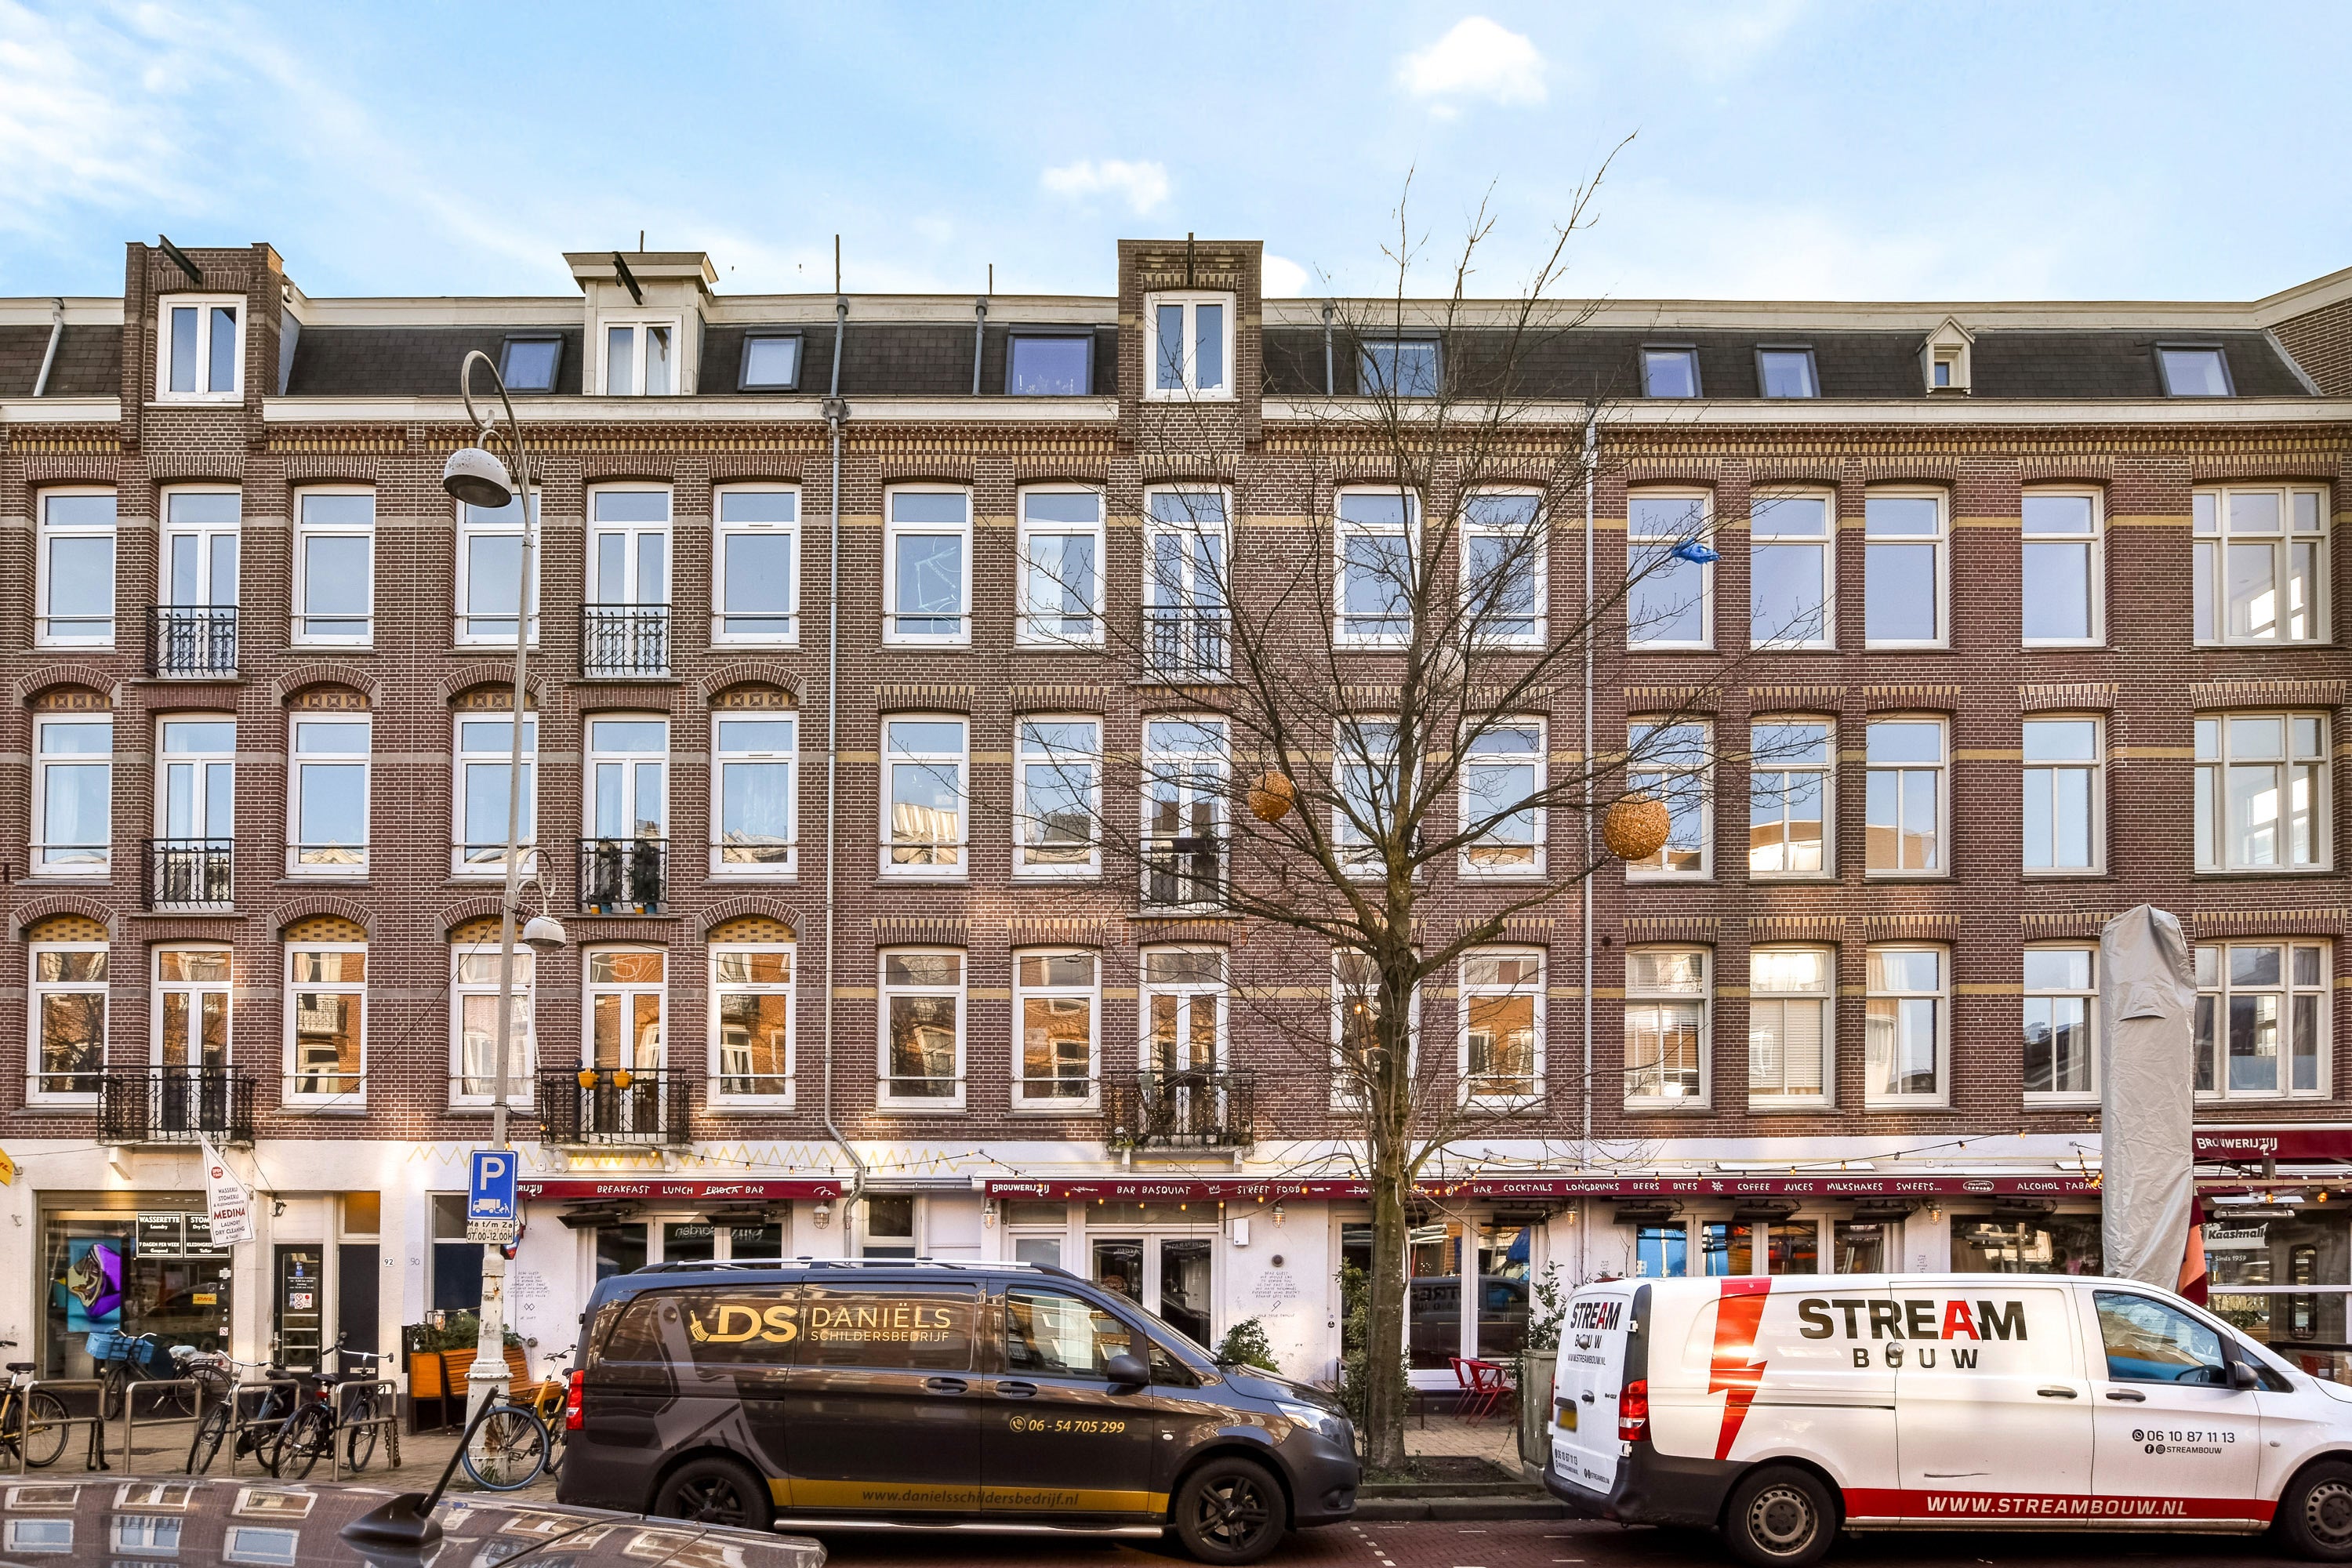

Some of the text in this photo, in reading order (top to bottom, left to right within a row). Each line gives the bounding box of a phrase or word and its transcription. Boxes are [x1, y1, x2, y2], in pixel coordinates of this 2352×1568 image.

[2196, 1138, 2259, 1149] BROUWERIJ
[480, 1156, 506, 1190] P
[597, 1185, 651, 1194] BREAKFAST
[745, 1185, 764, 1195] BAR
[992, 1184, 1036, 1192] BROUWERIJ
[1116, 1185, 1191, 1195] BAR BASQUIAT
[1237, 1185, 1301, 1195] STREET FOOD
[1473, 1185, 1492, 1193] BAR
[1503, 1184, 1553, 1192] COCKTAILS
[1566, 1181, 1620, 1192] LONGDRINKS
[1673, 1182, 1698, 1191] BITES
[1784, 1182, 1813, 1191] JUICES
[1827, 1182, 1883, 1191] MILKSHAKES
[213, 1207, 245, 1220] MEDINA
[467, 1232, 513, 1241] 07.00-12.00H
[410, 1258, 420, 1266] 90
[811, 1302, 951, 1328] DANIËLS
[1570, 1301, 1623, 1330] STREAM
[1798, 1298, 2027, 1342] STREAM
[706, 1305, 797, 1342] DS
[811, 1330, 949, 1341] SCHILDERSBEDRIJF
[1574, 1334, 1602, 1349] BUW
[1028, 1419, 1045, 1432] 06
[1054, 1420, 1071, 1432] 54
[1074, 1421, 1098, 1432] 705
[1100, 1421, 1125, 1433] 299
[2147, 1430, 2235, 1443] 06 10 87 11 13
[2166, 1446, 2223, 1454] STREAMBOUW
[862, 1489, 1080, 1508] www.danielsschildersbedrijf.nl
[1926, 1496, 2188, 1515] WWW.STREAMBOUW.NL
